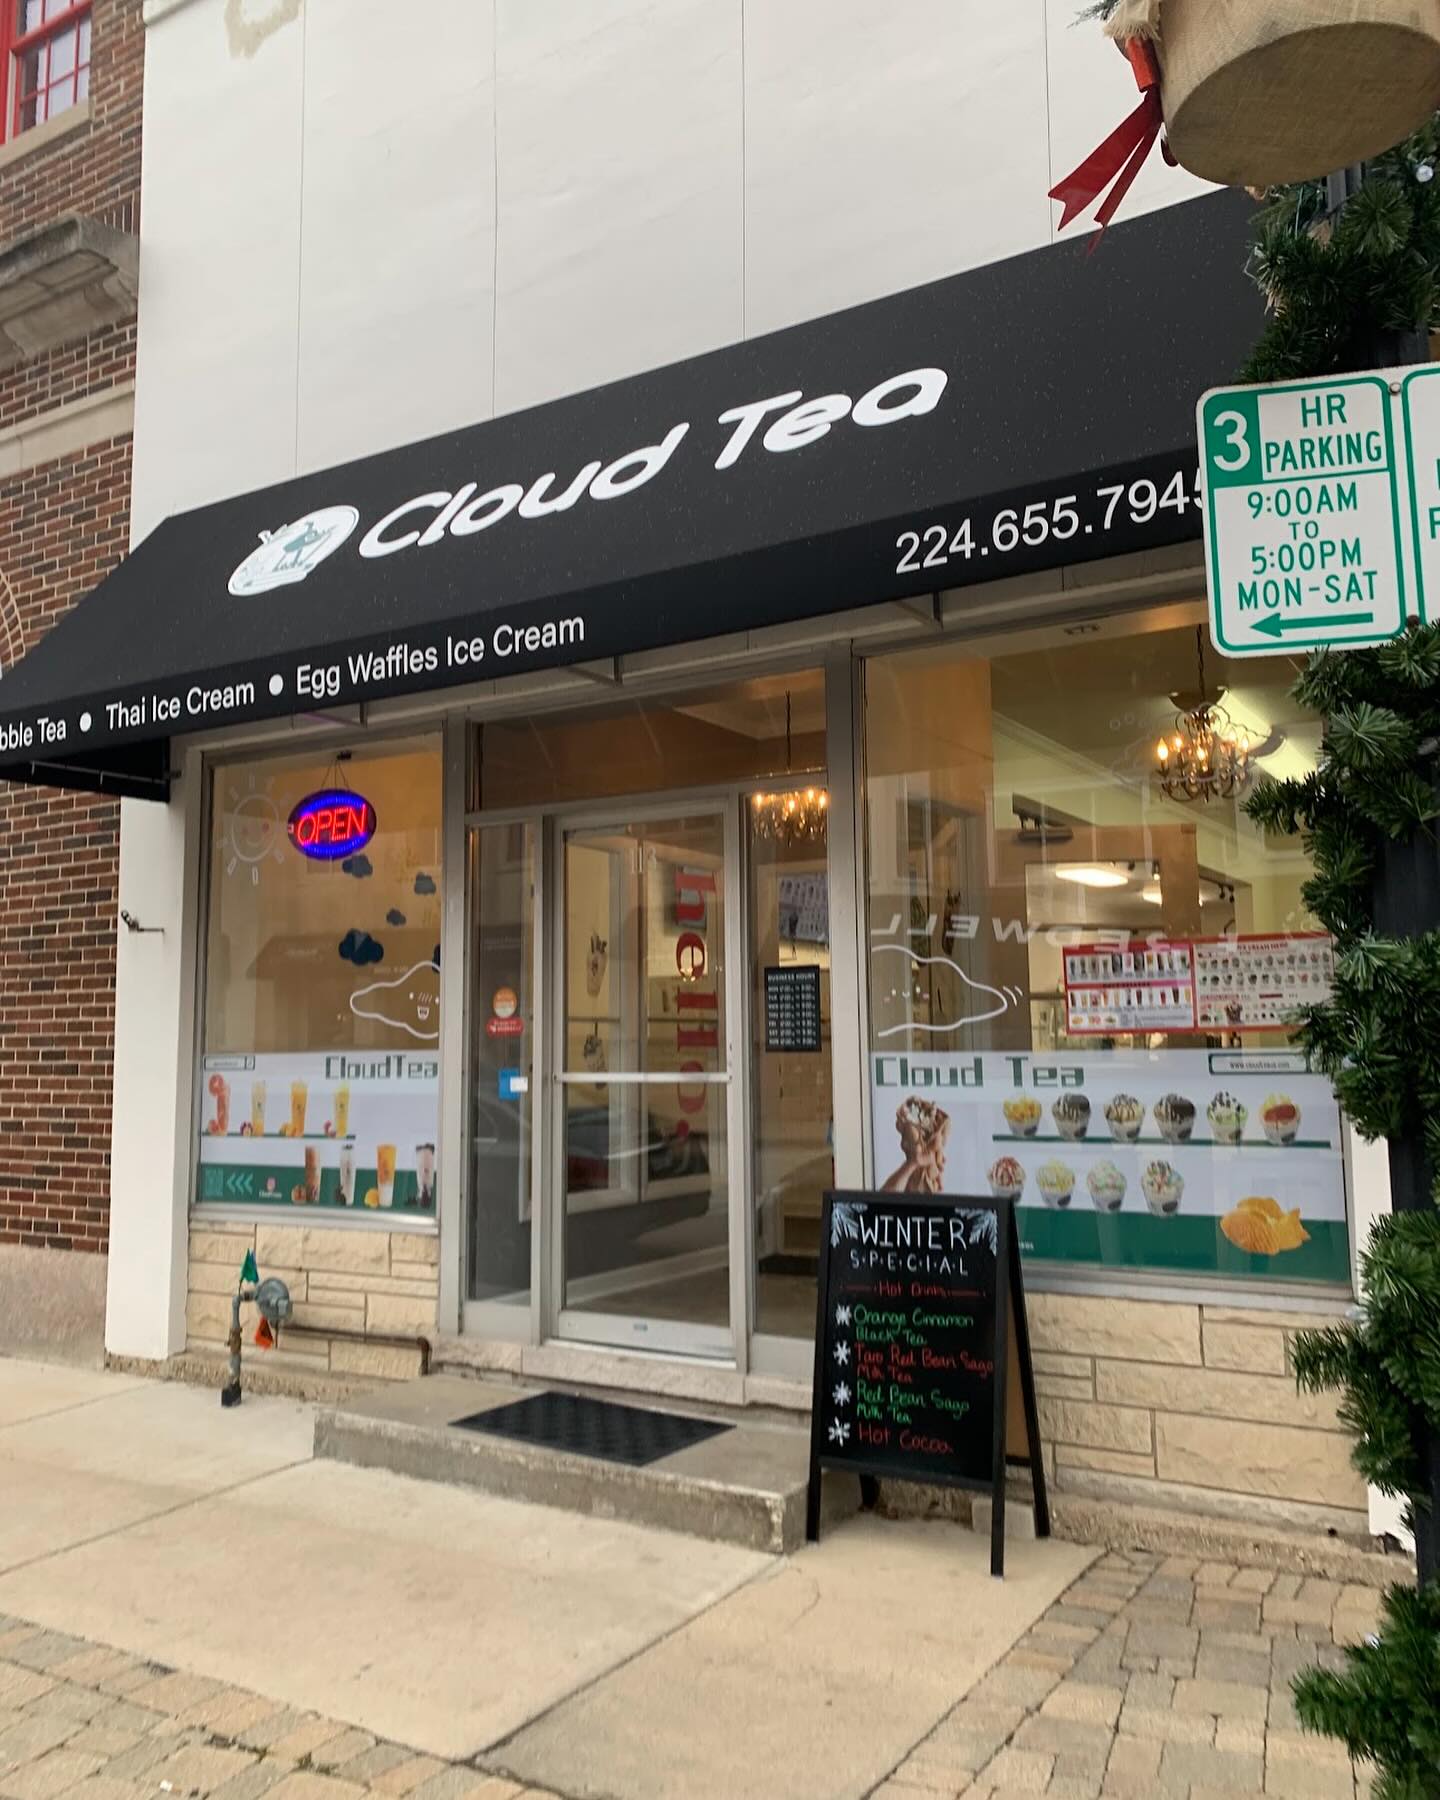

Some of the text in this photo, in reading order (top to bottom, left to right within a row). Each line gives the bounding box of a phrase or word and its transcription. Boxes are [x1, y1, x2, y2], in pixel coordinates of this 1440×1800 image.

[1301, 393, 1348, 428] HR
[1213, 409, 1251, 471] 3
[1264, 431, 1382, 473] PARKING
[358, 367, 948, 559] Cloud Tea
[1247, 481, 1358, 519] 9:00AM
[1288, 520, 1320, 541] TO
[1251, 537, 1362, 575] 5:00PM
[296, 616, 585, 699] Egg Waffles Ice Cream
[105, 681, 255, 730] Thai Ice Cream
[37, 716, 67, 744] Tea
[298, 804, 367, 847] OPEN
[876, 1056, 1085, 1089] Cloud Tea
[858, 1215, 968, 1250] WINTER
[853, 1303, 975, 1332] Orange Cinnamon
[856, 1327, 928, 1346] Black Tea
[890, 1343, 915, 1366] Red
[921, 1347, 957, 1369] Bean
[887, 1365, 913, 1384] Tea
[856, 1379, 885, 1402] Red
[889, 1384, 927, 1408] Bean
[886, 1405, 913, 1426] Tea
[858, 1423, 954, 1455] Hot Cocoa
